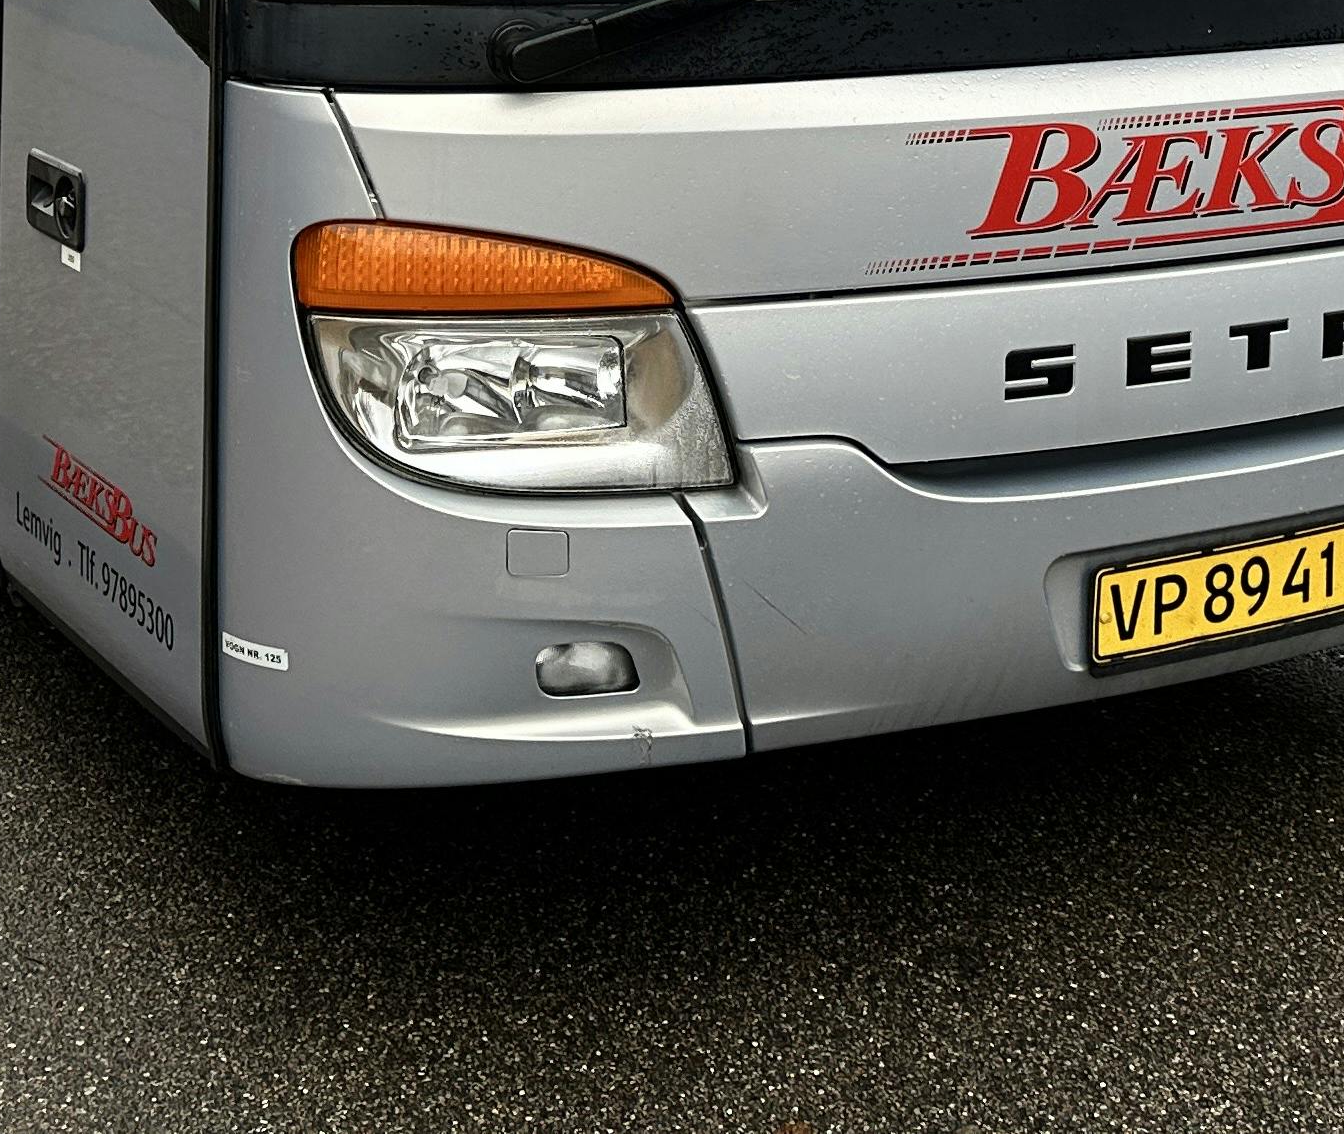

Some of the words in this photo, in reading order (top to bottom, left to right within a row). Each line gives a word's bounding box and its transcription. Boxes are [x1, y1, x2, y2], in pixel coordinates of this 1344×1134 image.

[16, 491, 61, 566] Lemvig
[1110, 574, 1188, 642] VP
[264, 652, 282, 664] 125
